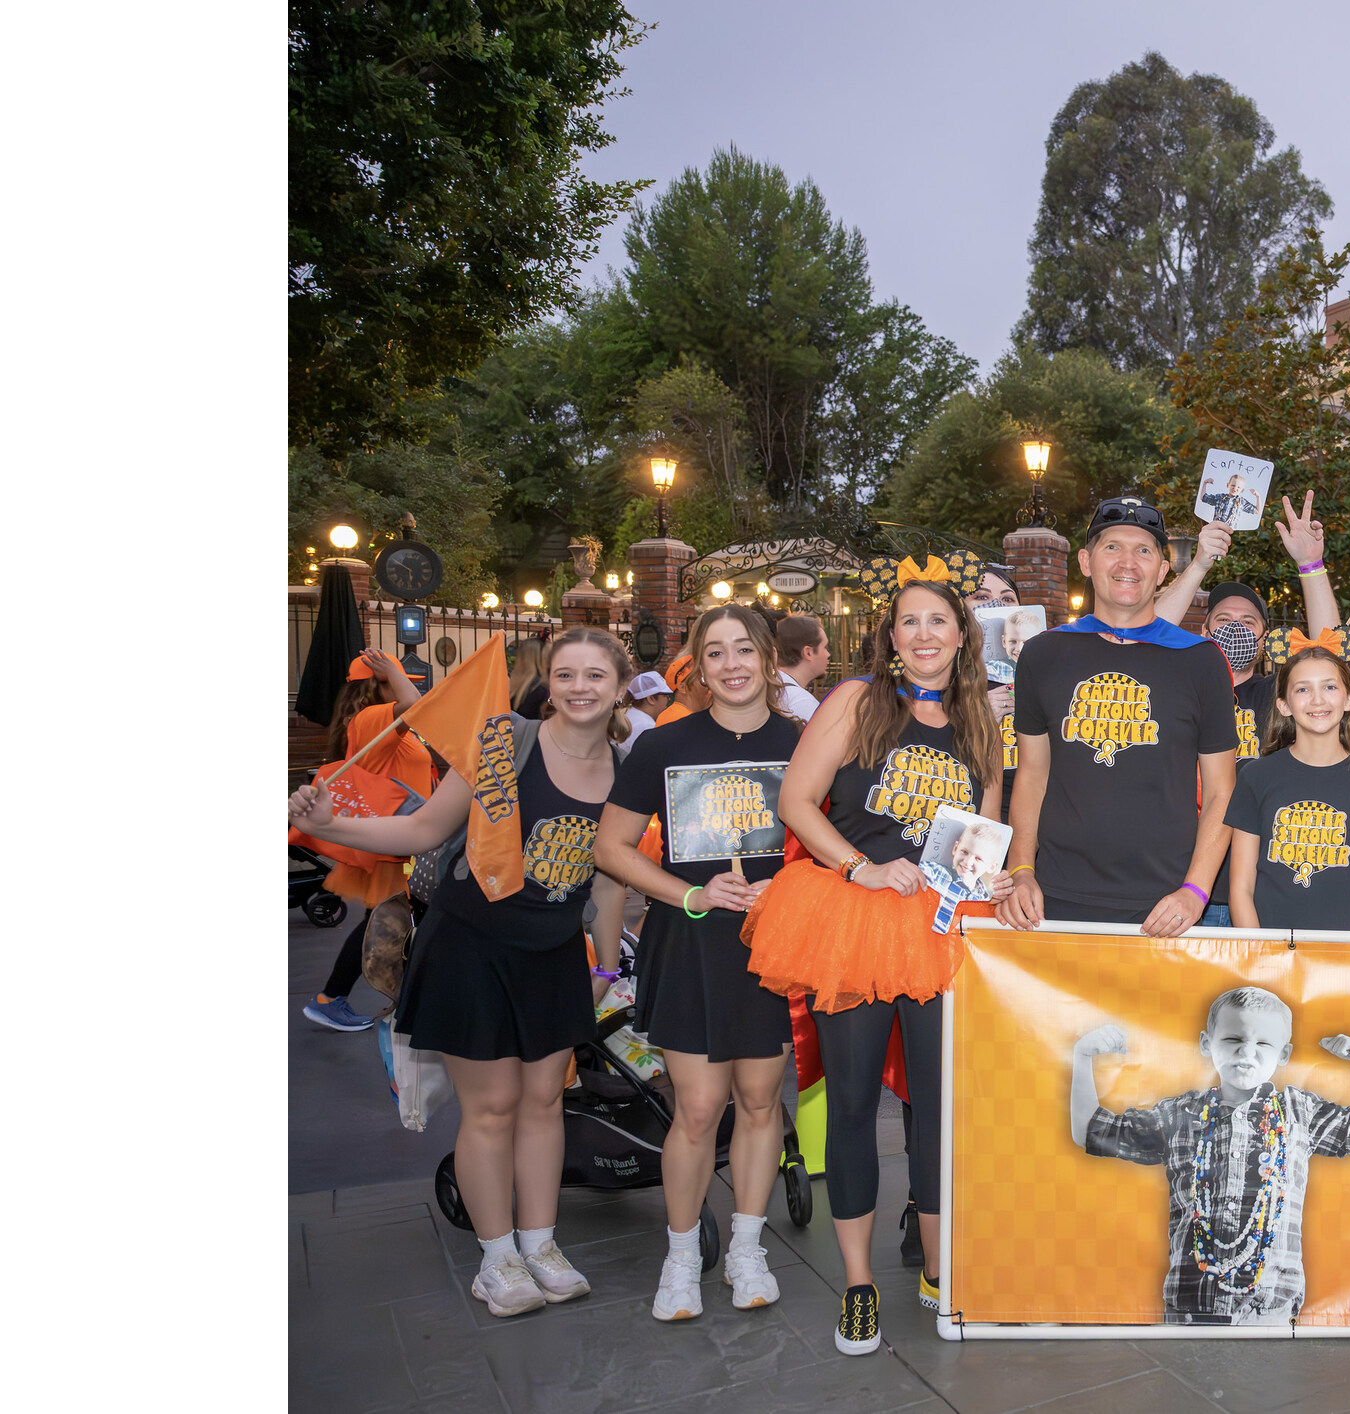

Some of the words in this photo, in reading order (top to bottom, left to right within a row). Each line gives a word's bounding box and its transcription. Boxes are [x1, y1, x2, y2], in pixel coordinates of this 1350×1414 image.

[1078, 684, 1148, 702] CARTER
[1073, 700, 1147, 720] STRONG
[1065, 718, 1157, 742] FOREVER
[892, 752, 969, 782] CARTER
[704, 784, 760, 799] CARTER
[886, 771, 971, 804] STRONG
[704, 797, 764, 813] STRONG
[701, 811, 772, 830] FOREVER
[1278, 809, 1346, 828] CARTER
[536, 823, 596, 850] CART
[1276, 826, 1343, 845] STRONG
[1270, 841, 1350, 865] FOREVER
